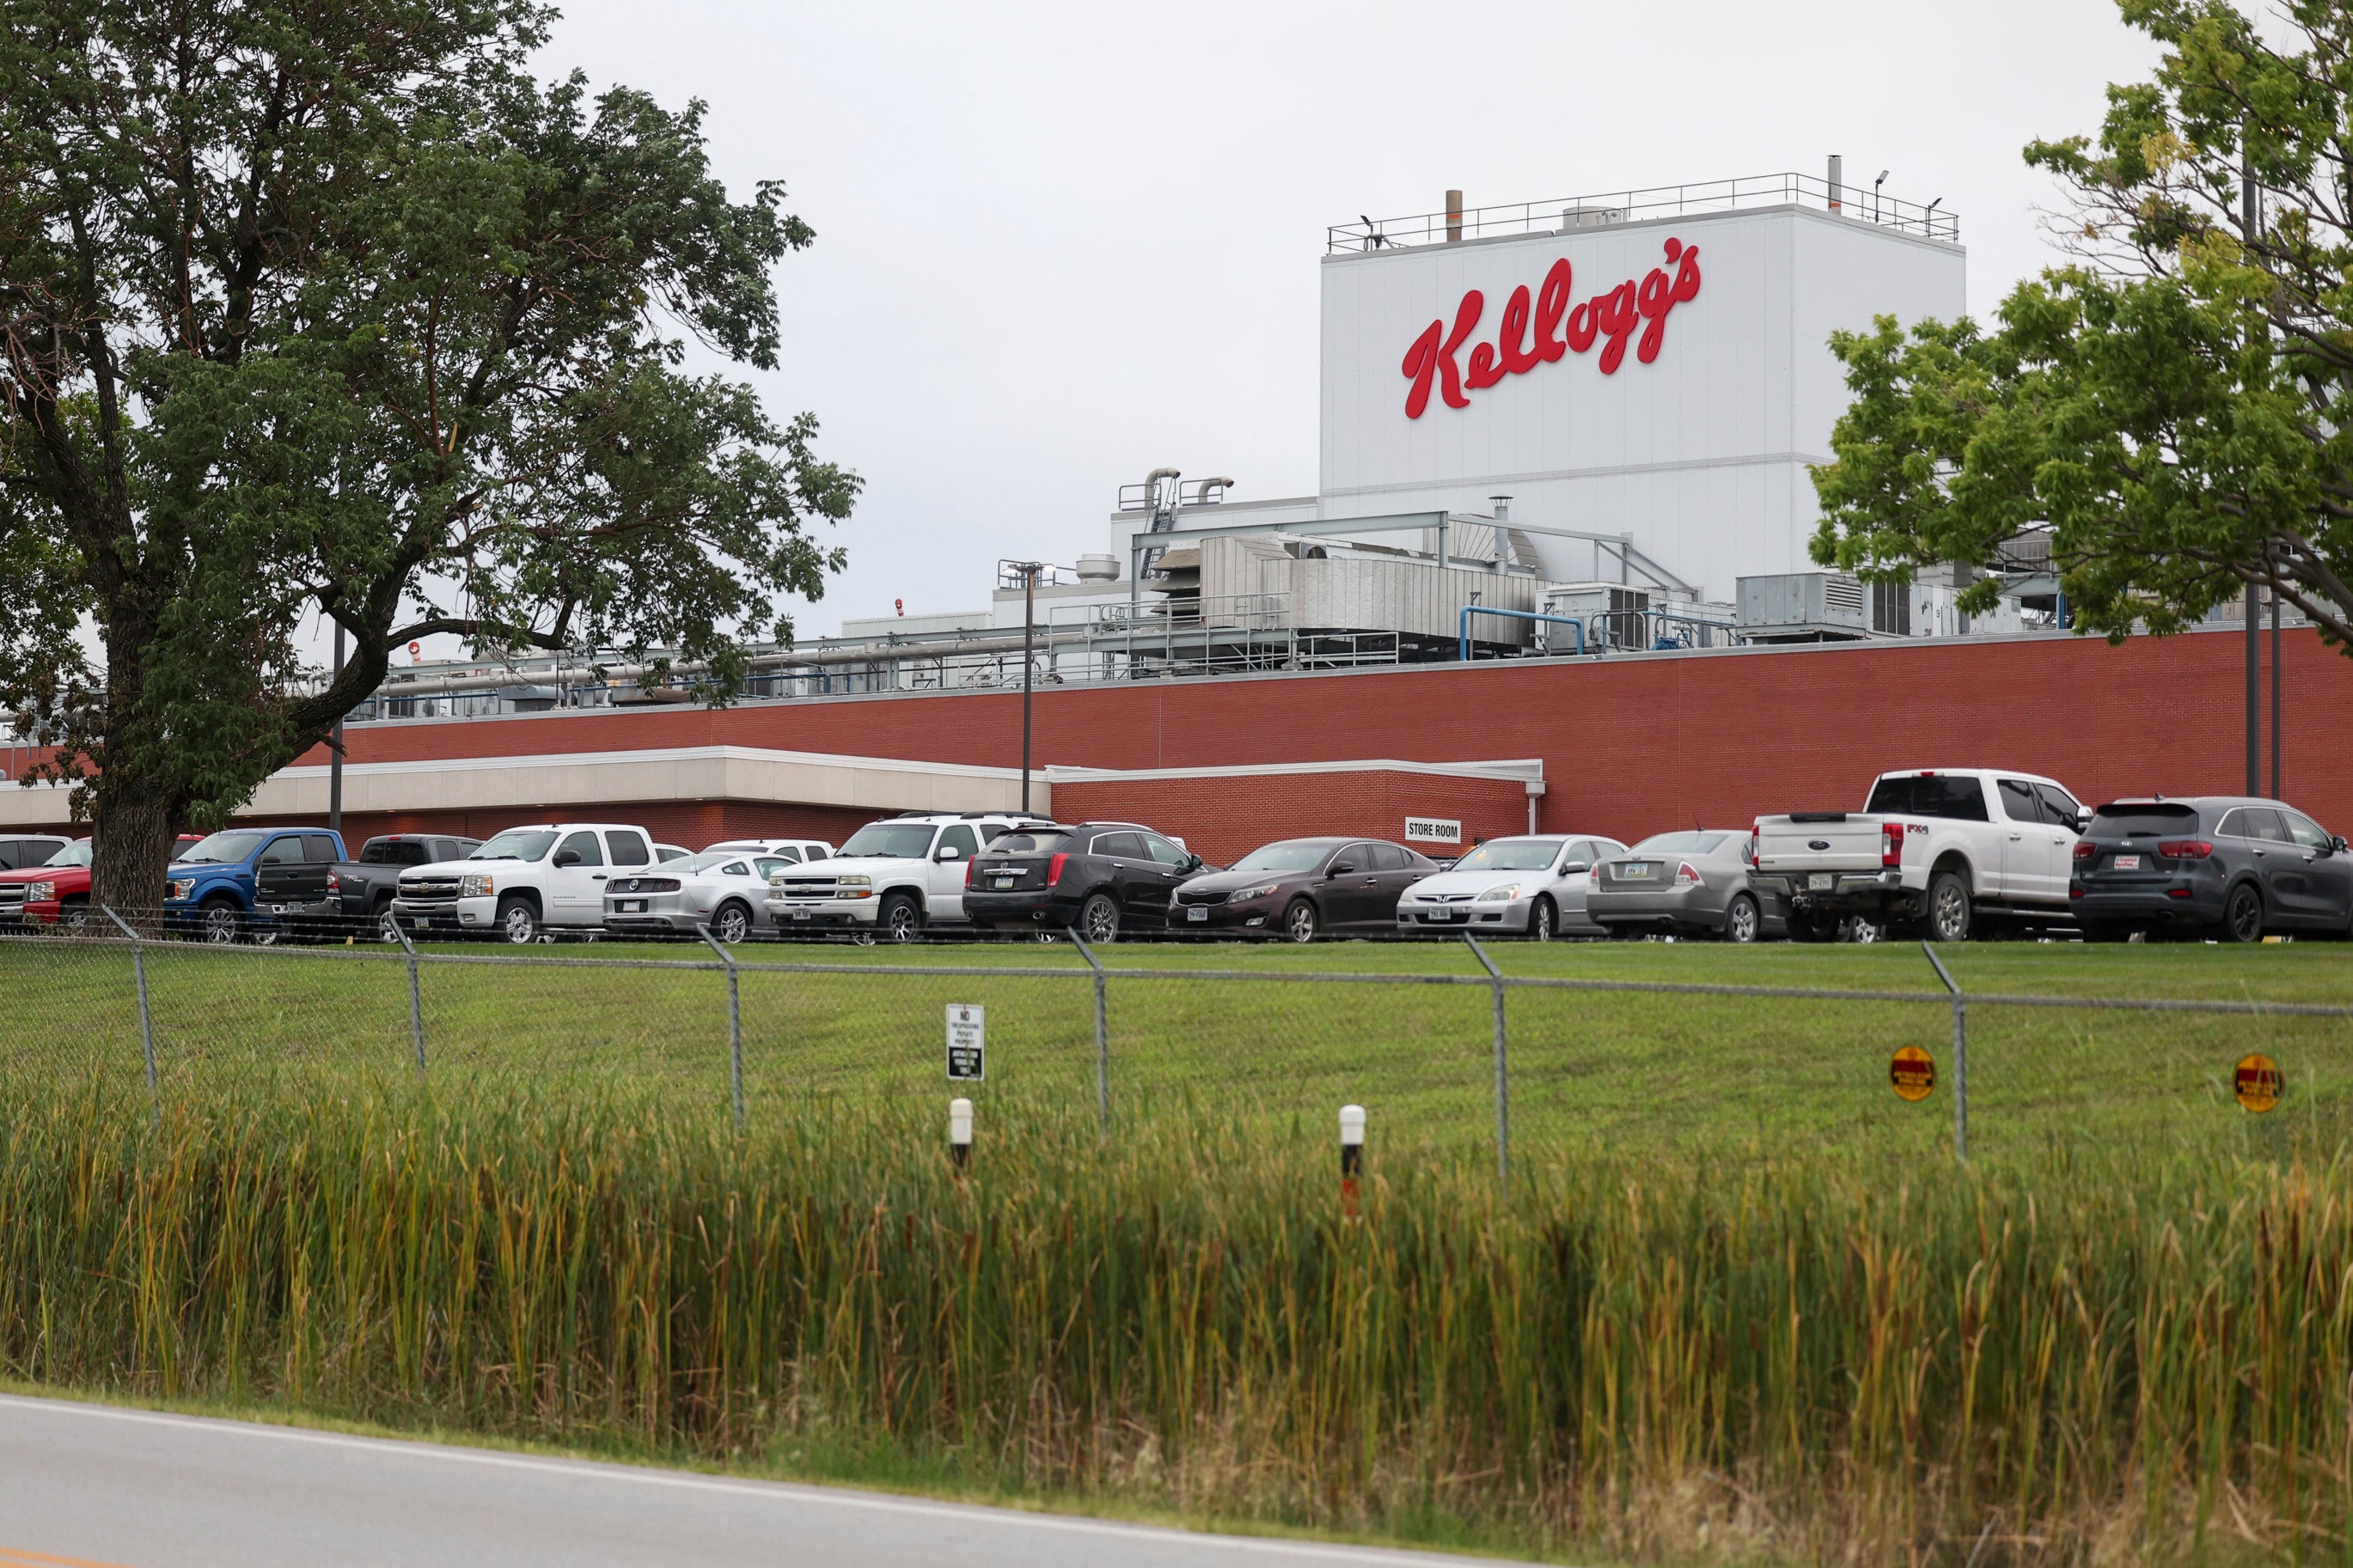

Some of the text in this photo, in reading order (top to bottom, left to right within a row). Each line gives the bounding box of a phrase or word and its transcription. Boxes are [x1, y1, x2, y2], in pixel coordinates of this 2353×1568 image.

[1402, 237, 1701, 419] Kellogg's
[1409, 822, 1458, 838] STORE ROOM
[1907, 824, 1928, 835] FX4
[960, 1010, 970, 1021] NO
